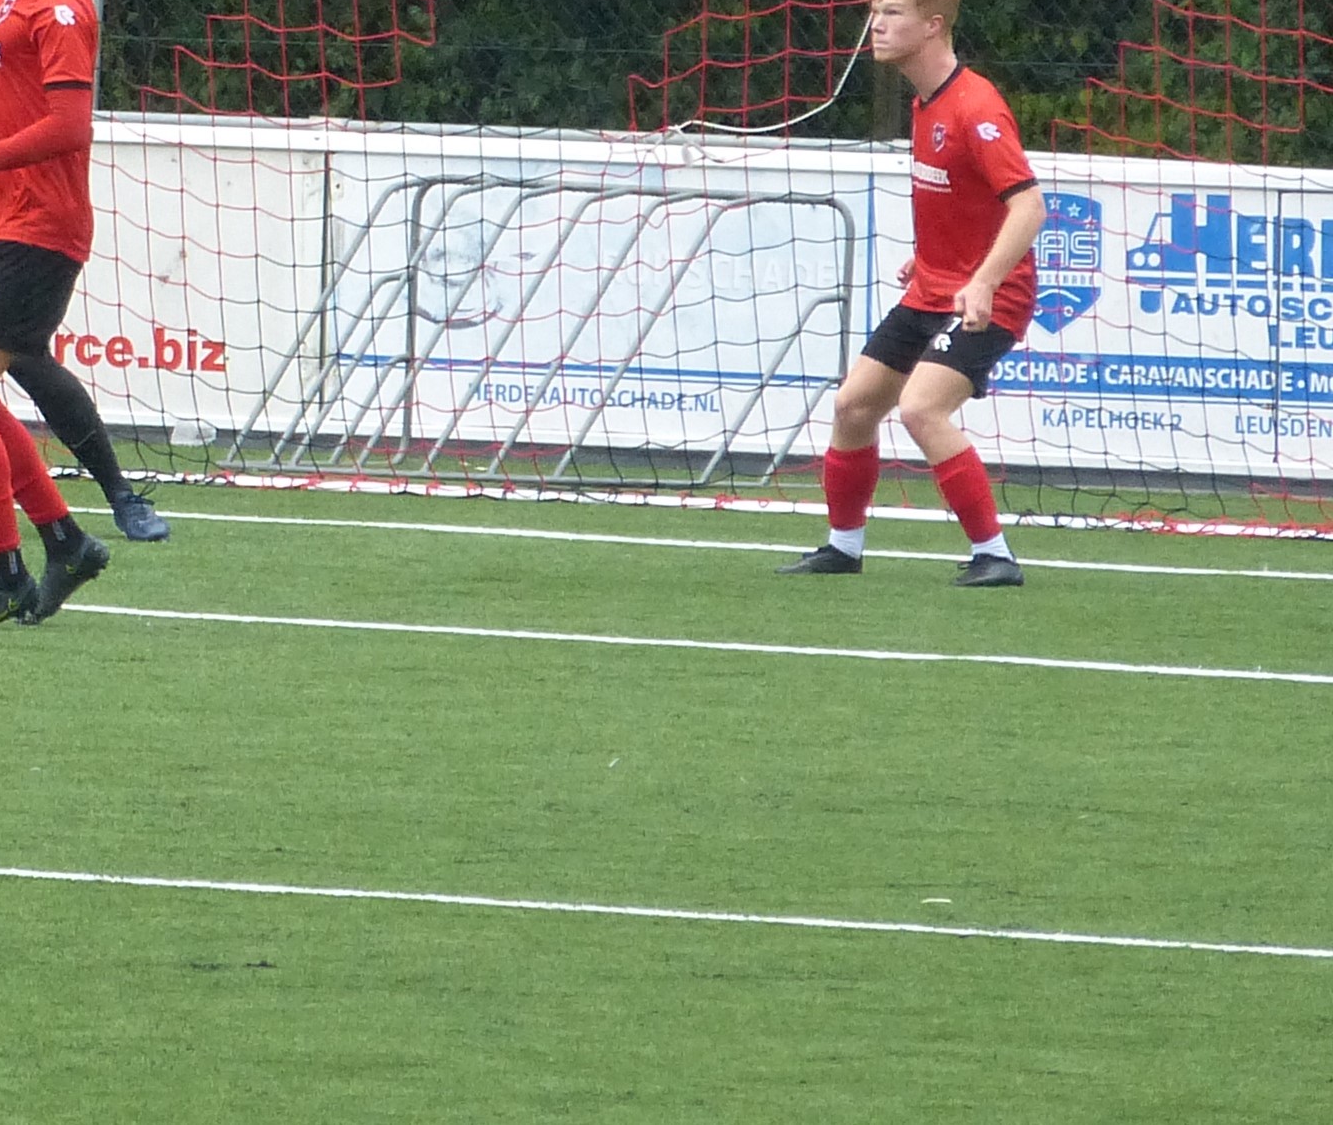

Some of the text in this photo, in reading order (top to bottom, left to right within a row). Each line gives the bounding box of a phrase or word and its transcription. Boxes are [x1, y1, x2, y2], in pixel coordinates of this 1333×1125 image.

[1104, 364, 1294, 393] CARAVANSCHADE
[1041, 408, 1167, 432] KAPELHOEK
[1234, 415, 1333, 439] LEUSDEN
